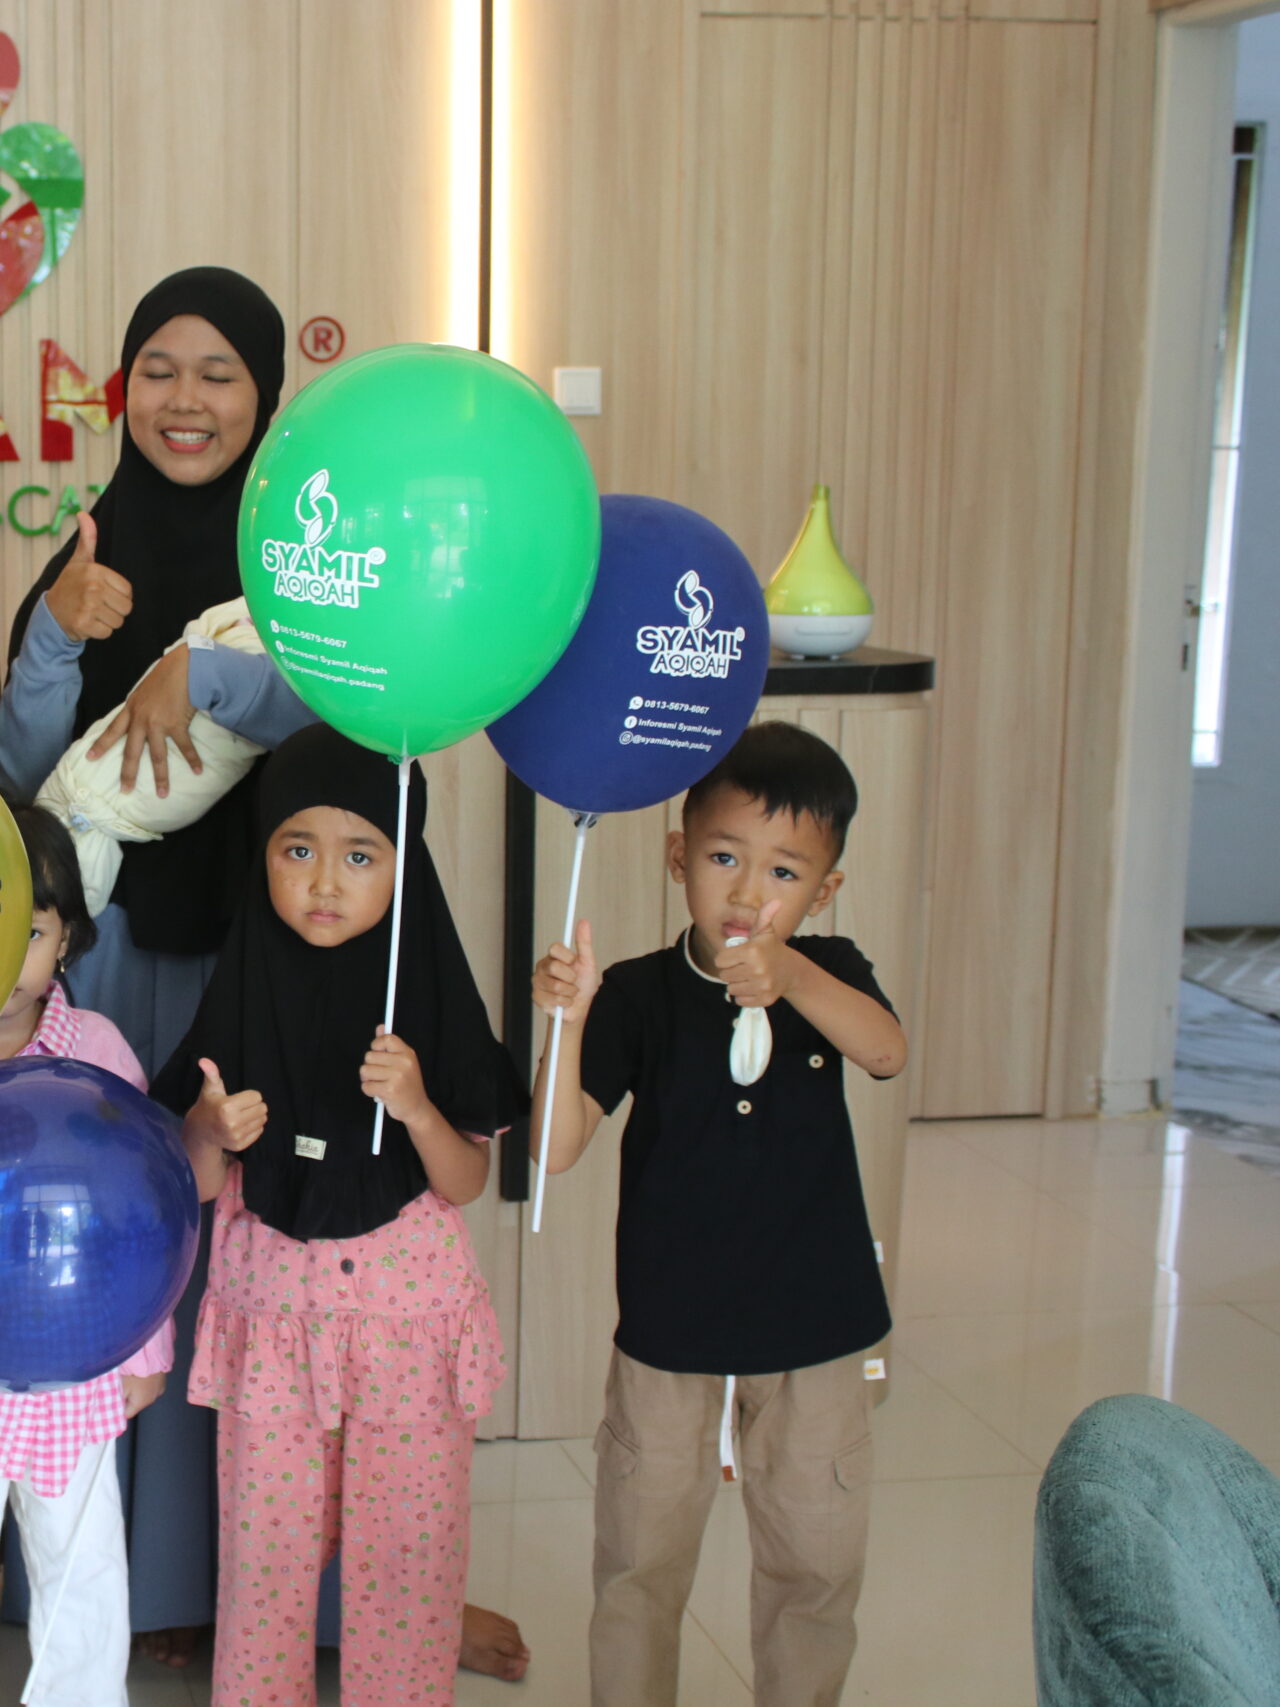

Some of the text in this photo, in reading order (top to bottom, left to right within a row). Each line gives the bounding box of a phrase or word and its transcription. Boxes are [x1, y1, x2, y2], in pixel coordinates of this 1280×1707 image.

[262, 539, 379, 588] SYAMIL
[274, 571, 359, 608] AQIQAH
[636, 626, 742, 660] SYAMIL
[650, 651, 729, 679] AQIQAH
[644, 700, 710, 714] 0813-5679-6067
[638, 718, 677, 730] Inforesmi
[677, 722, 702, 733] Syamil
